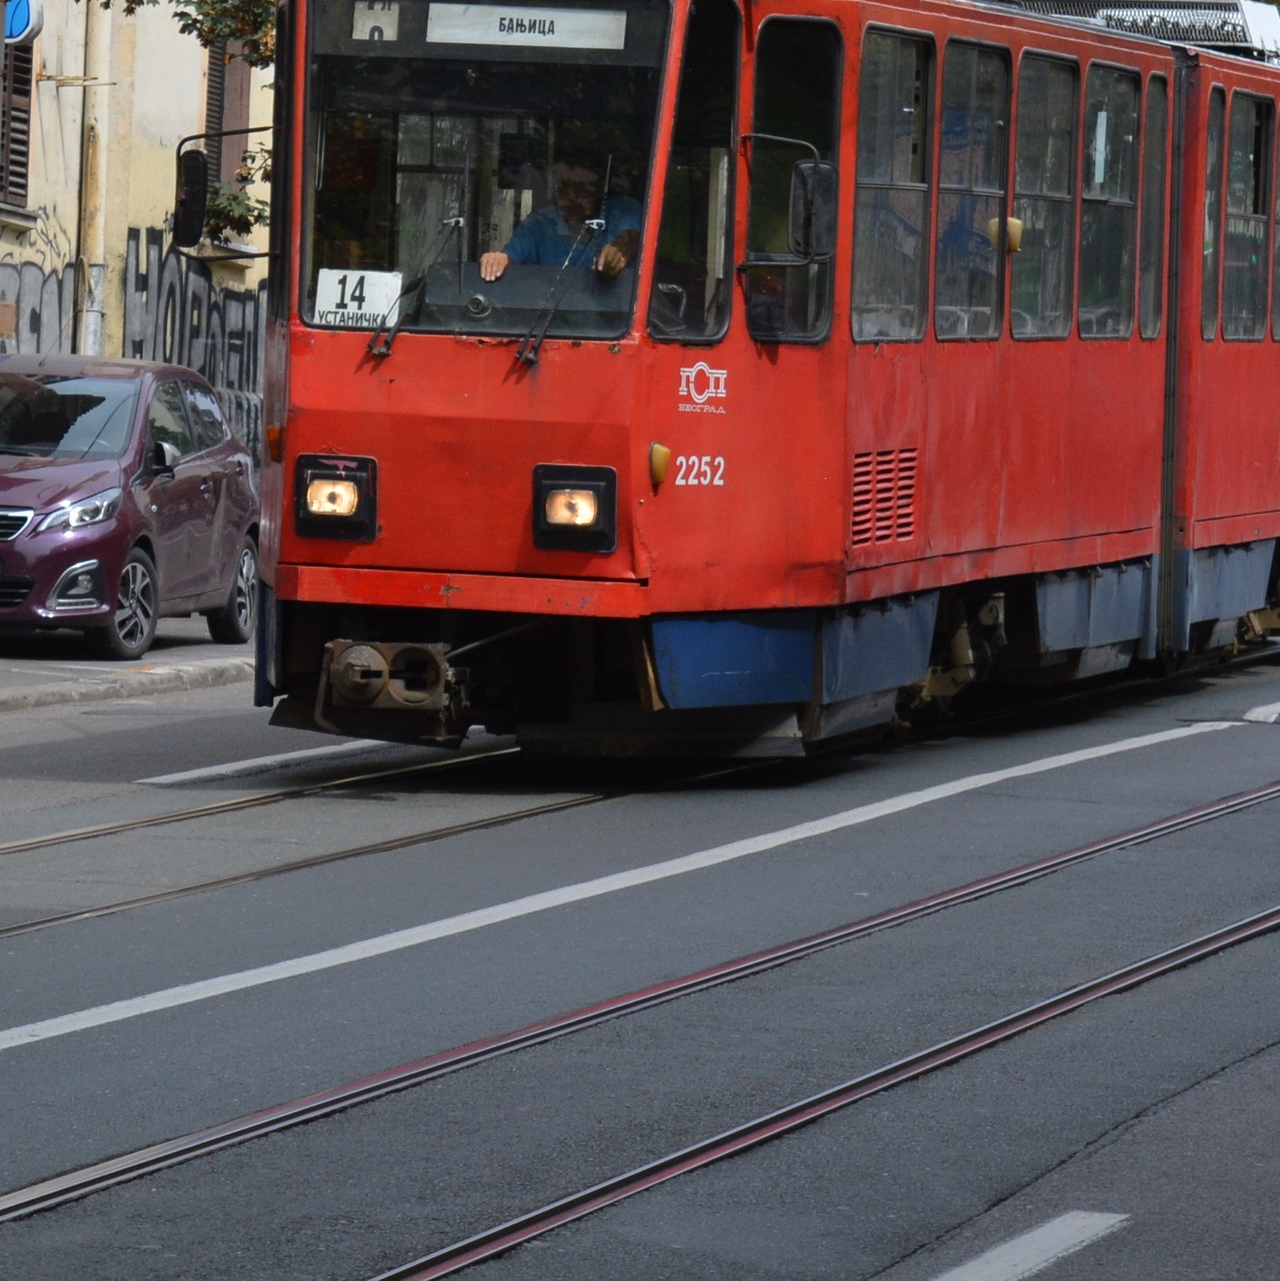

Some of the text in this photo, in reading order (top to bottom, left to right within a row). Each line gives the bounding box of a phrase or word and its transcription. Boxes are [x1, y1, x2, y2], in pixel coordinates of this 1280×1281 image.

[498, 16, 556, 36] БАЊИЦА
[334, 274, 366, 311] 14
[678, 361, 728, 403] ГСП
[677, 403, 726, 414] БЕОГРАД
[674, 455, 726, 486] 2252
